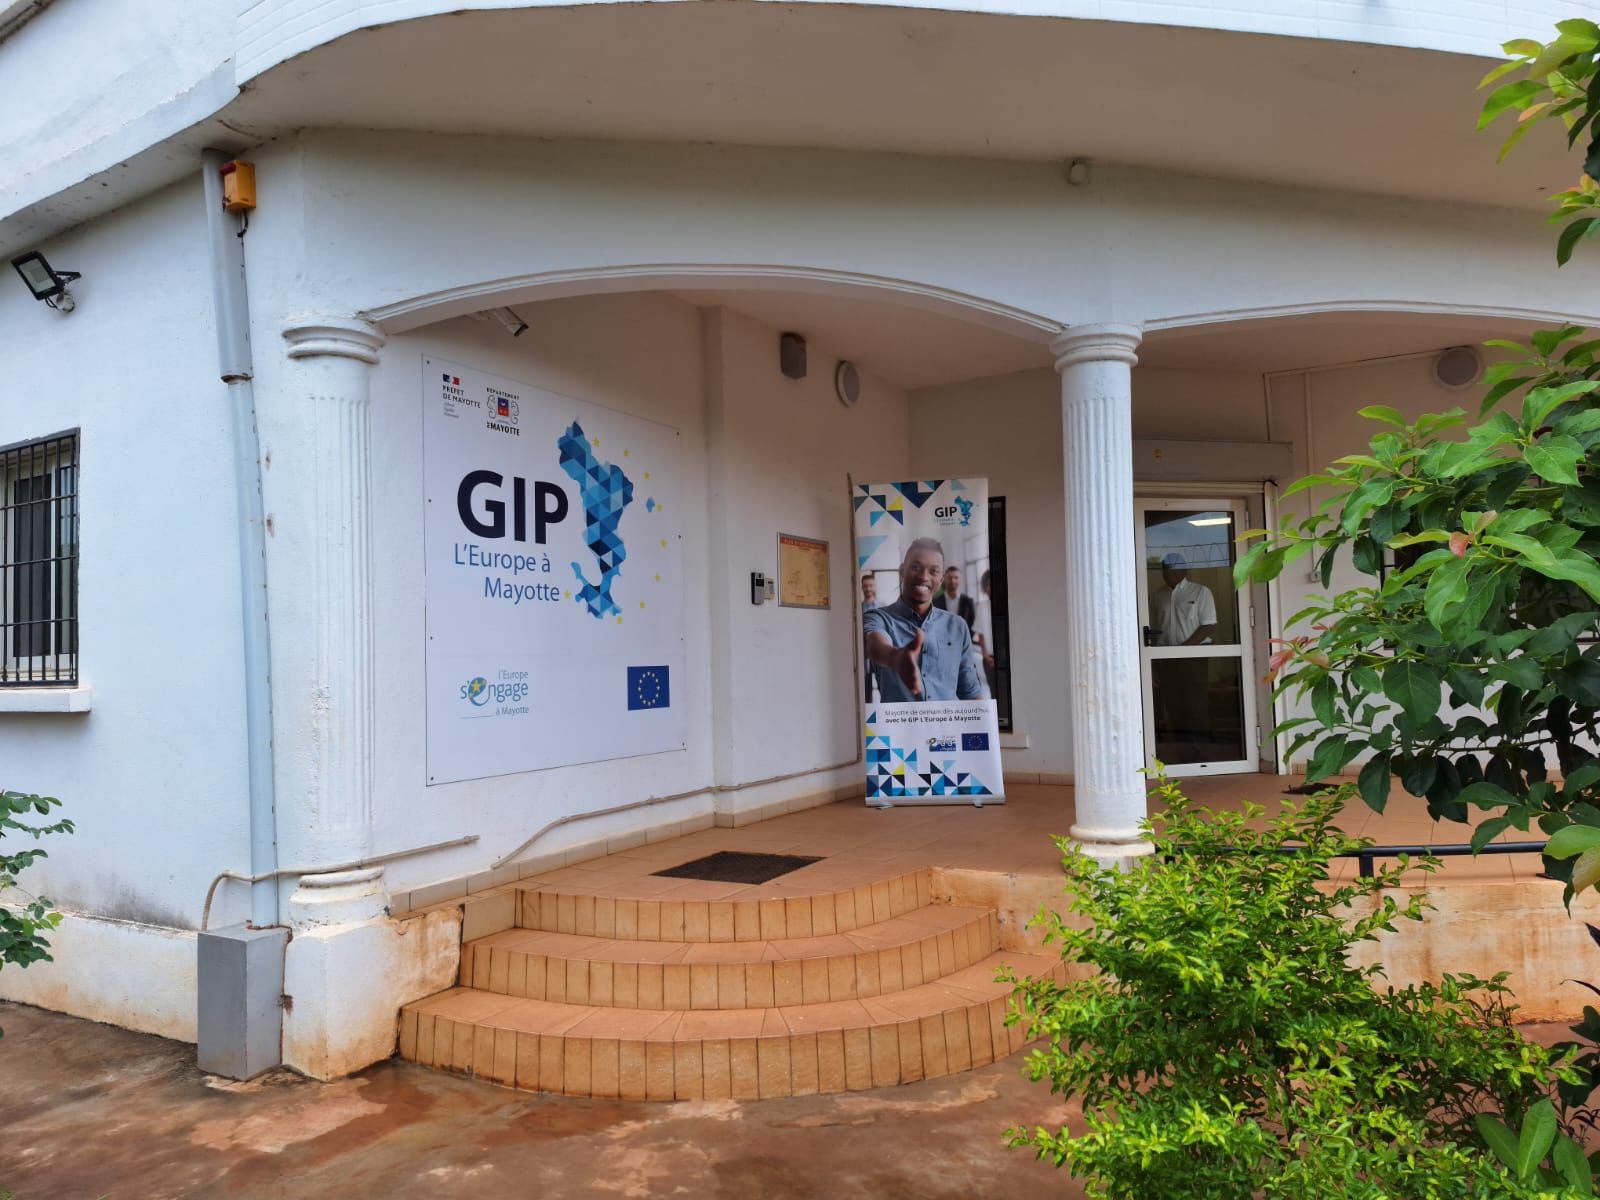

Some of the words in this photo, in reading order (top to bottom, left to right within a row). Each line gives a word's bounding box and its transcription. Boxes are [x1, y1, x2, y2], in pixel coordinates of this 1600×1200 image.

[443, 393, 451, 401] DE
[452, 395, 480, 408] MAYOTTE
[457, 469, 569, 545] GIP
[934, 506, 957, 518] GIP
[455, 543, 536, 575] L'Europe
[541, 553, 551, 573] à
[484, 576, 560, 605] Mayotte
[501, 705, 529, 716] Mayotte
[953, 715, 981, 723] Mayotte
